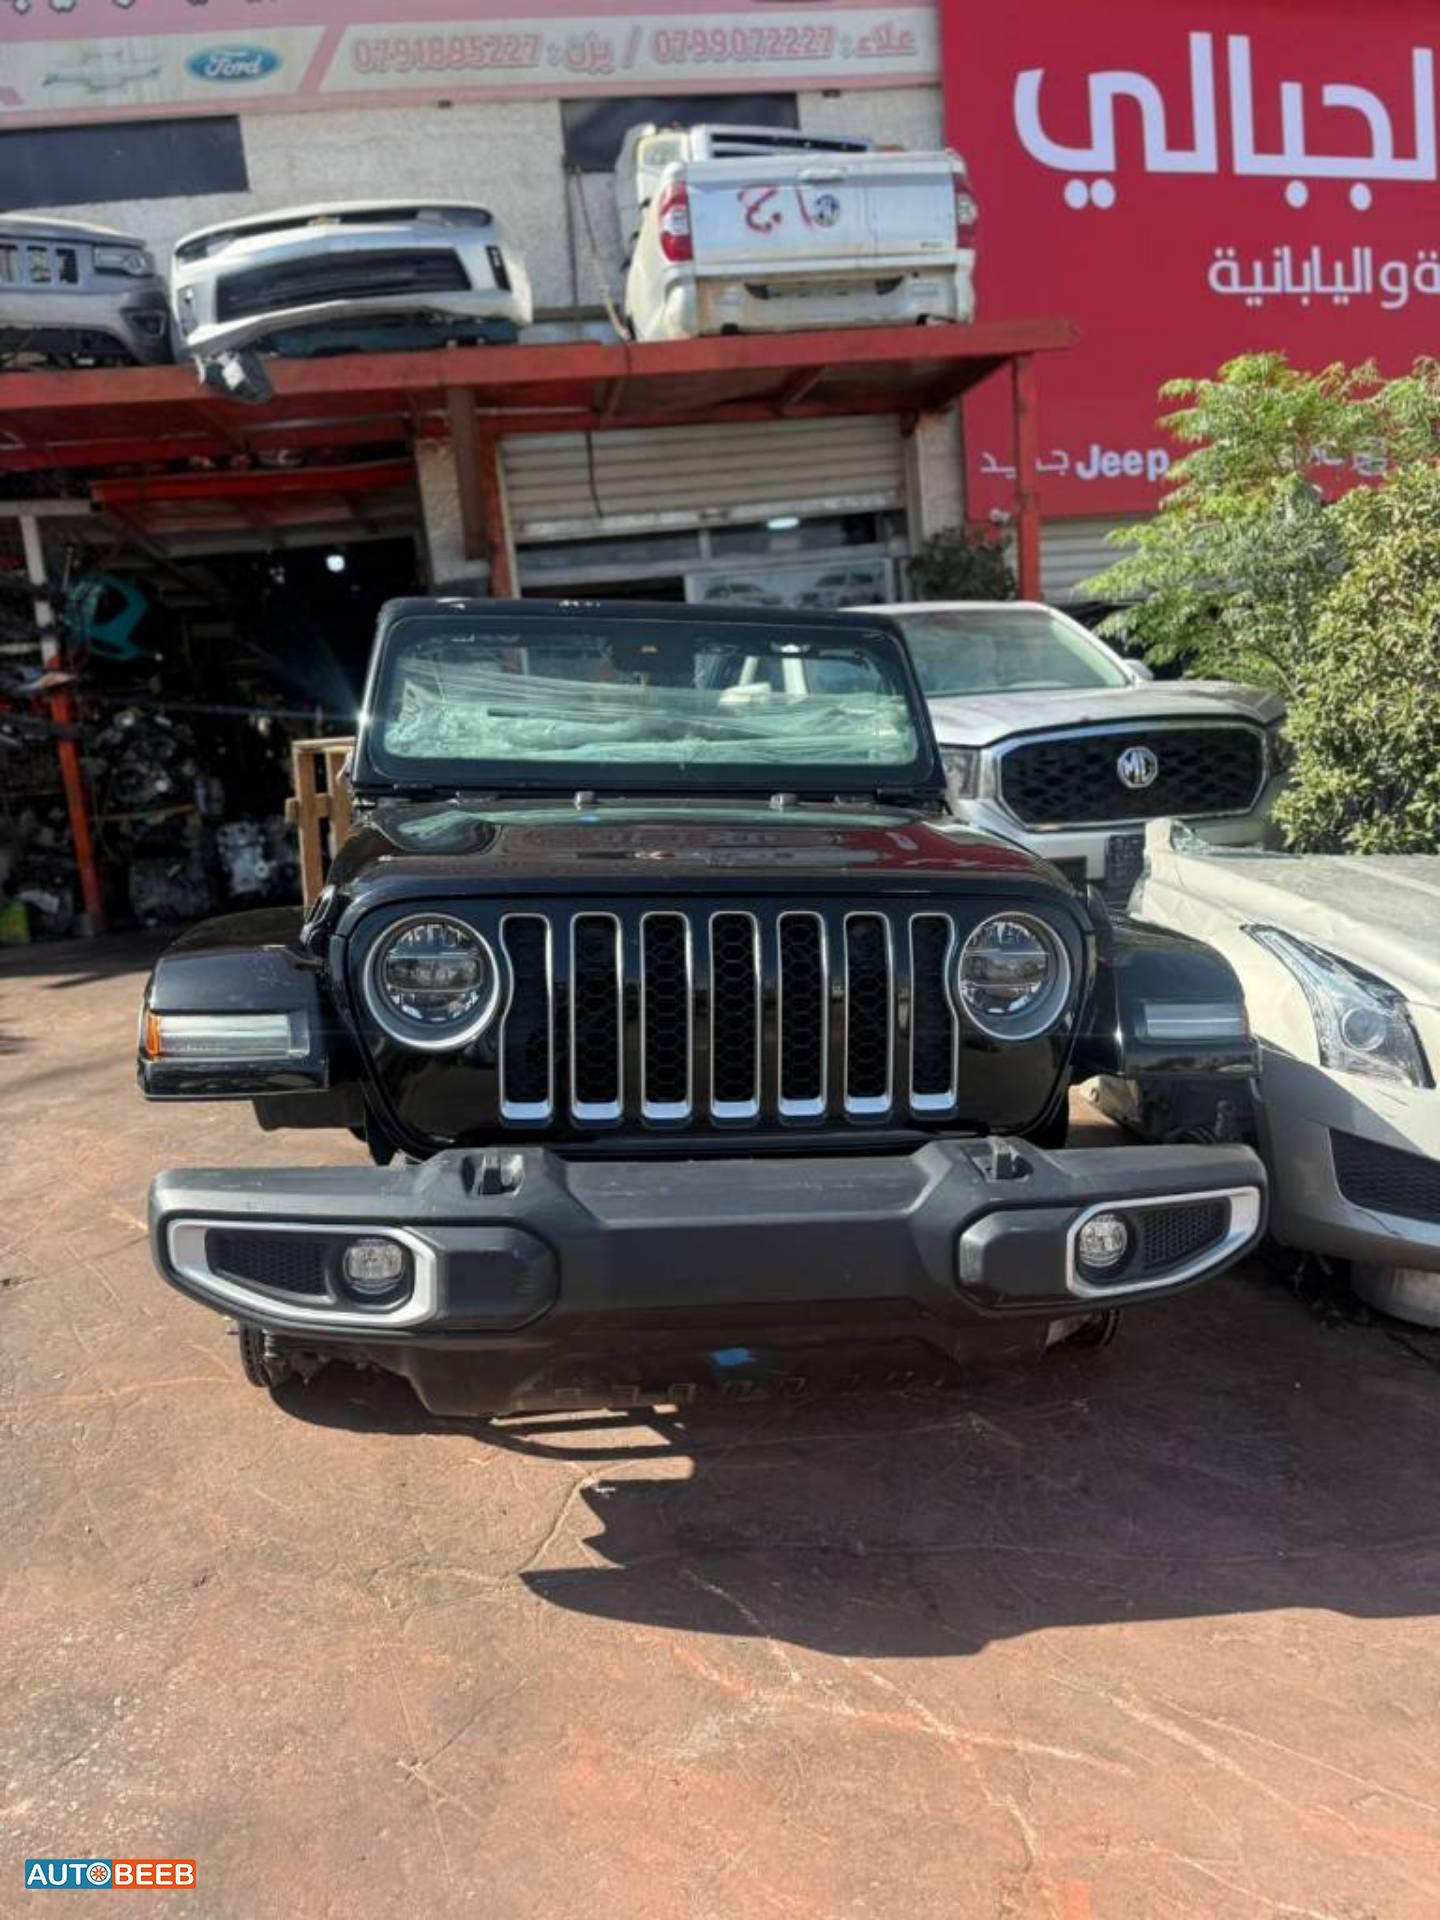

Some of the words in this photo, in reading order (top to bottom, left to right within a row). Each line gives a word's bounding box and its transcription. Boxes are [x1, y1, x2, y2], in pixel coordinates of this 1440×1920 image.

[204, 49, 264, 78] Ford
[1075, 444, 1170, 481] Jeep
[1122, 749, 1155, 785] MG
